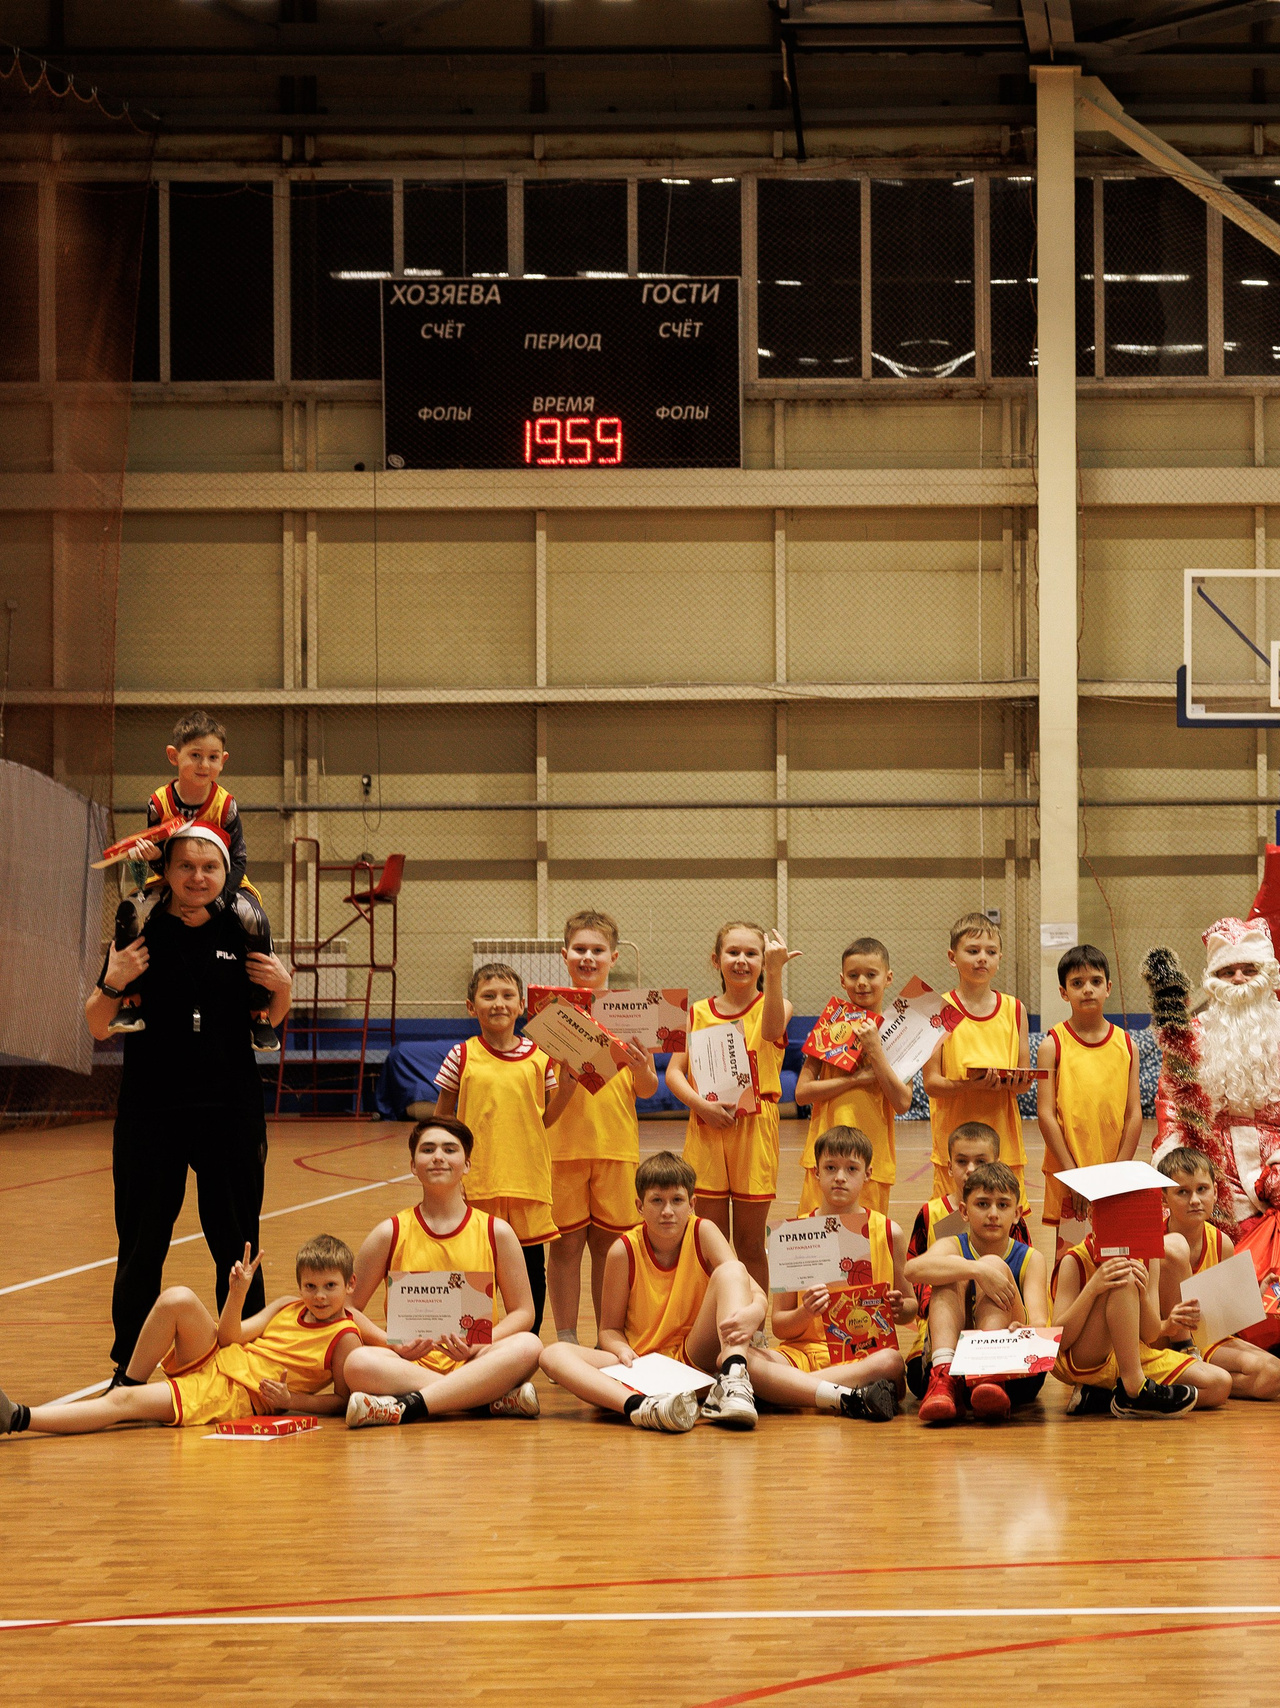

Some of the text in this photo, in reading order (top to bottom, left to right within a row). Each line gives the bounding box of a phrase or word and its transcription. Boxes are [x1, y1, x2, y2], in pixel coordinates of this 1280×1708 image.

[390, 284, 501, 305] ХОЗЯЕВА
[641, 283, 720, 304] ГОСТИ
[420, 319, 465, 339] СЧЁТ
[659, 318, 703, 338] СЧЁТ
[524, 333, 602, 351] ПЕРИОД
[532, 396, 596, 412] ВРЕМЯ
[656, 405, 709, 420] ФОЛЫ
[418, 406, 472, 421] ФОЛЫ
[216, 950, 237, 960] FILA
[603, 1002, 649, 1011] ГРАМОТА
[556, 1009, 596, 1043] ГРАМОТА
[880, 1014, 906, 1045] АМОТА
[727, 1032, 738, 1077] ГРАМОТА
[779, 1231, 828, 1243] ГРАМОТА
[400, 1286, 450, 1294] ГРАМОТА
